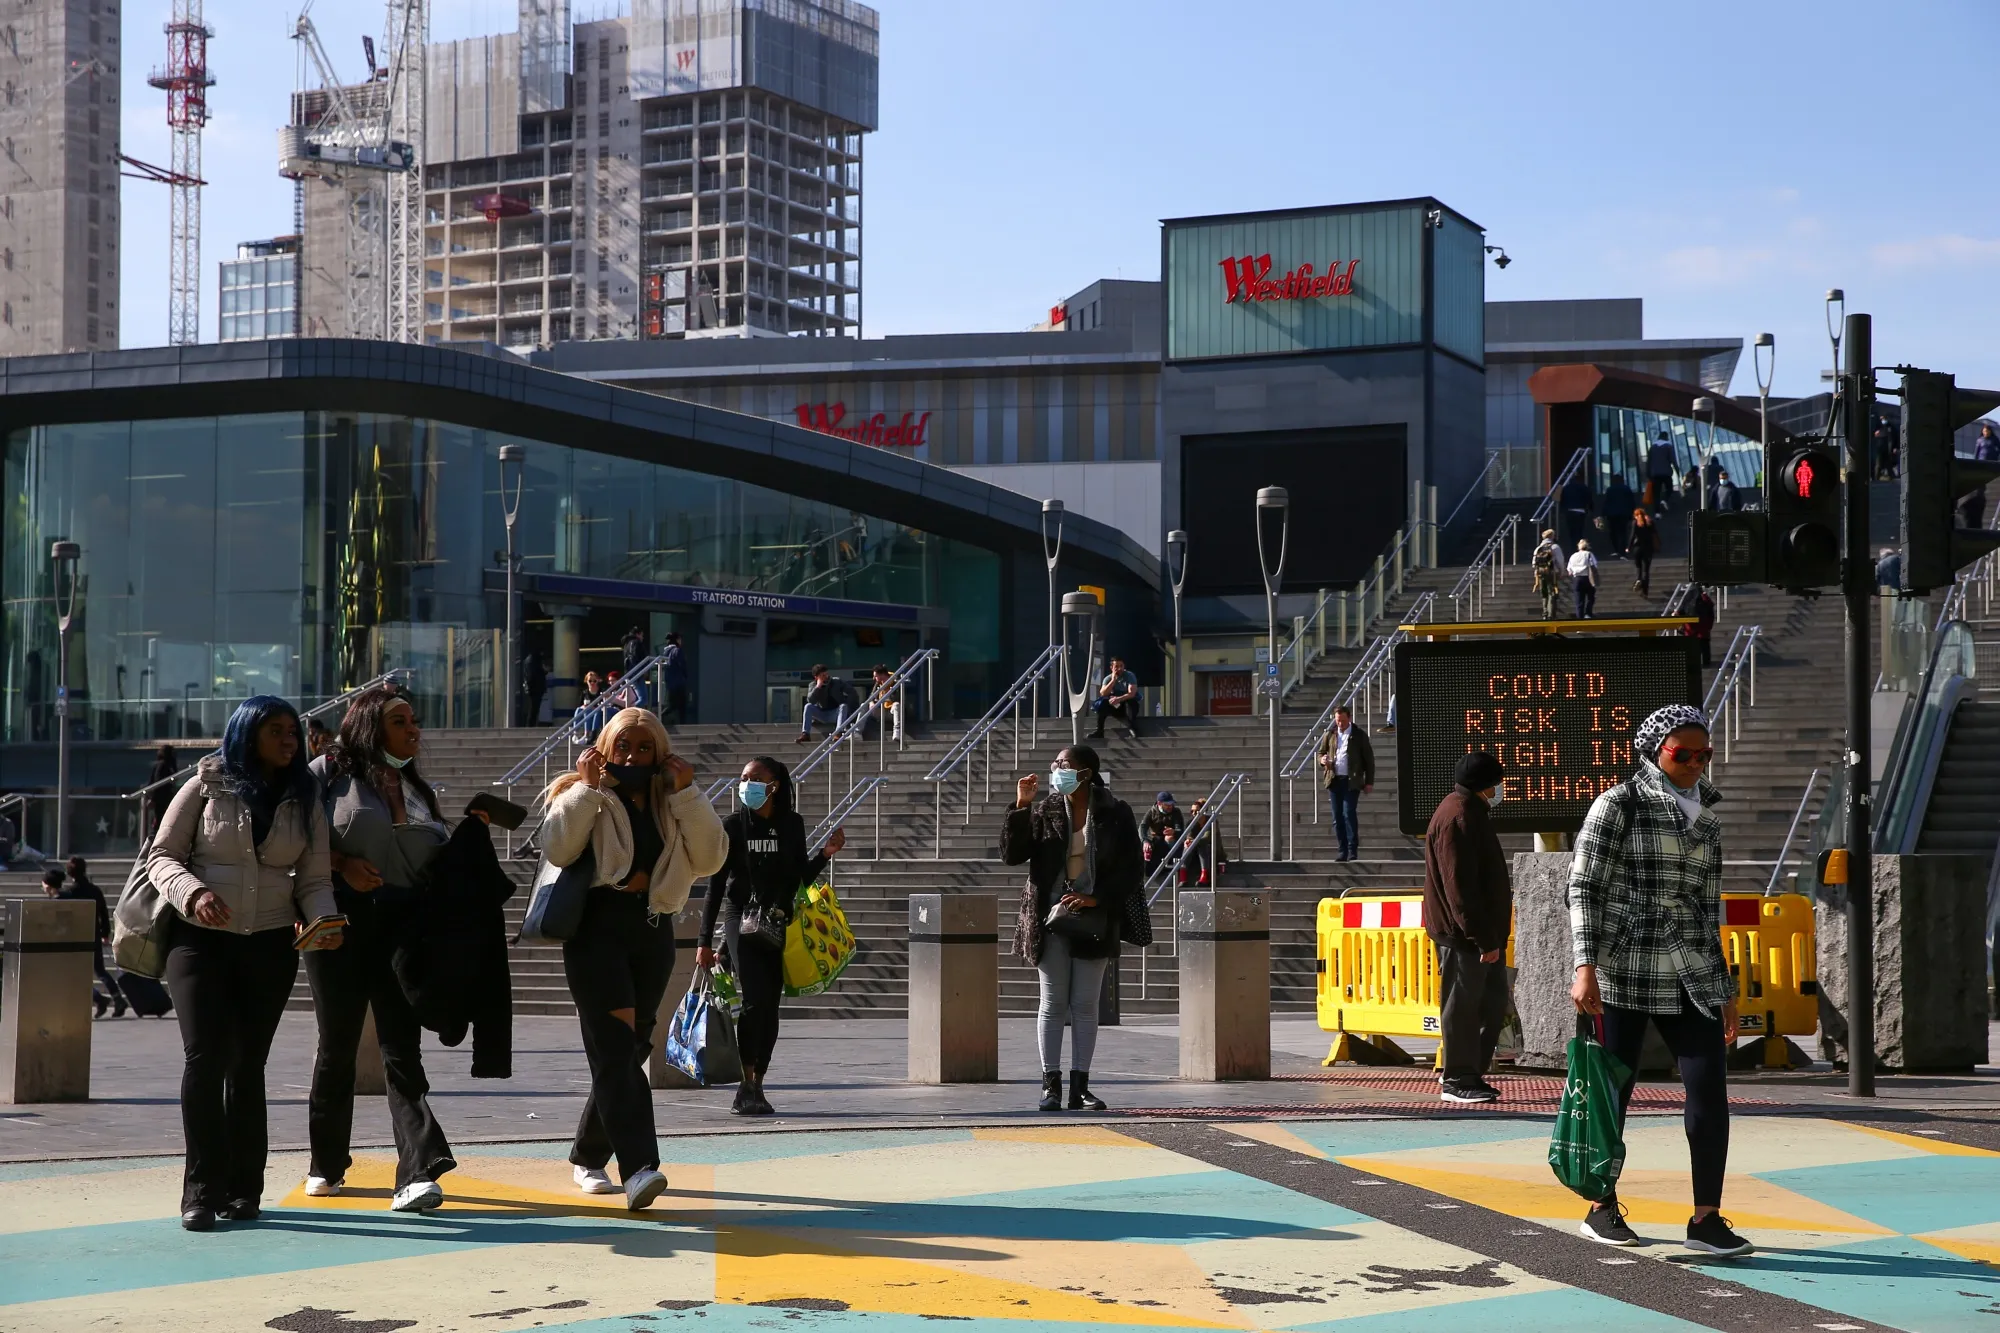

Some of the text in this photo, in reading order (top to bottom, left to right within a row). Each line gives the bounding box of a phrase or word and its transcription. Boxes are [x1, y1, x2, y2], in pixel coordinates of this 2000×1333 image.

[618, 86, 629, 95] 20
[1218, 253, 1361, 304] Westfield
[618, 286, 629, 295] 14
[692, 590, 785, 608] STRATFORD STATION
[1489, 673, 1604, 699] COVID
[1466, 706, 1629, 733] RISK IS
[1591, 740, 1630, 765] IN
[1502, 774, 1618, 801] EWHAM
[747, 839, 778, 852] PUMA
[1423, 1016, 1440, 1029] SRL
